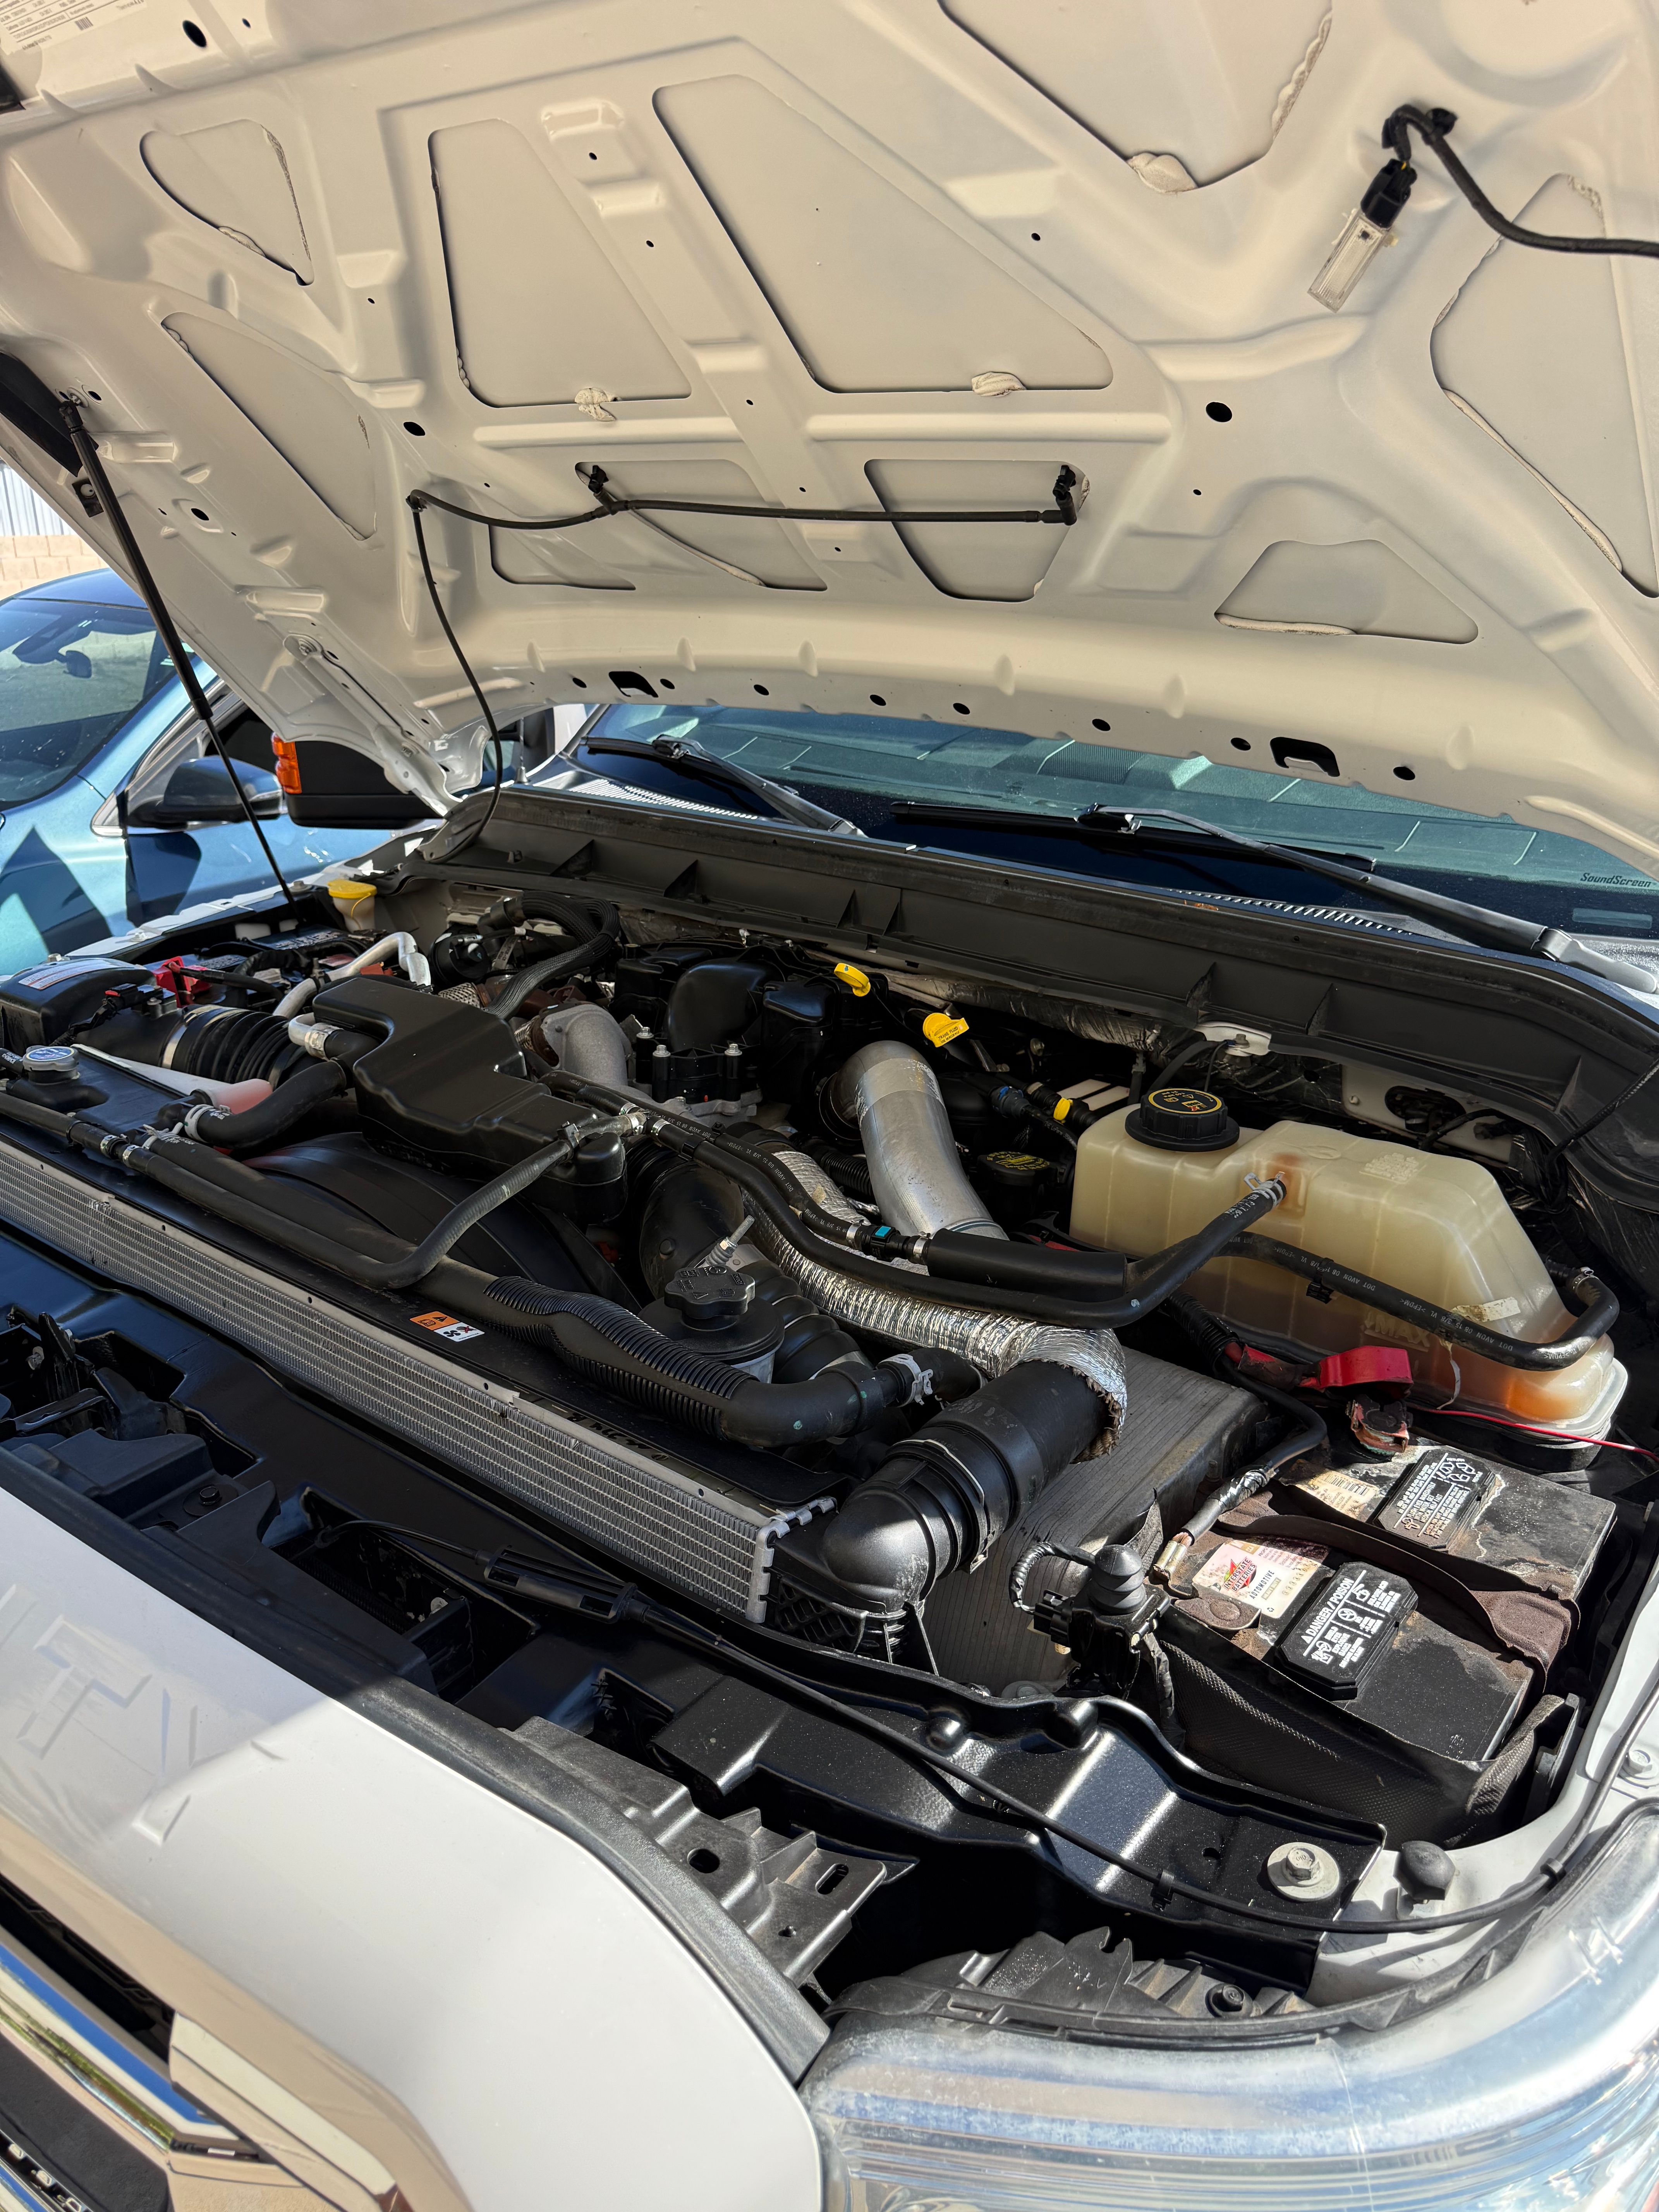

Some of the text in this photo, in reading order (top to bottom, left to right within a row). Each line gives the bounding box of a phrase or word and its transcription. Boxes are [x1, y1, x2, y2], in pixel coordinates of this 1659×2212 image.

[1580, 872, 1652, 888] SoundScreen
[938, 1032, 949, 1040] TRANS
[775, 1168, 786, 1180] AVON
[785, 1182, 794, 1192] DOT
[1273, 1245, 1296, 1258] >EPDM<
[1343, 1273, 1360, 1284] AVON
[1362, 1282, 1376, 1291] DOT
[1375, 1314, 1431, 1347] MAX
[1399, 1298, 1513, 1351] DOT AVON 08 15 3/8 VL >EPDM<
[1434, 1493, 1443, 1502] FAST
[1224, 1558, 1251, 1589] INTERSTATE
[1231, 1564, 1256, 1591] BATTERIES
[1249, 1570, 1275, 1599] AUTOMOTIVE
[1305, 1606, 1332, 1639] DANGER
[1333, 1578, 1355, 1604] POISON
